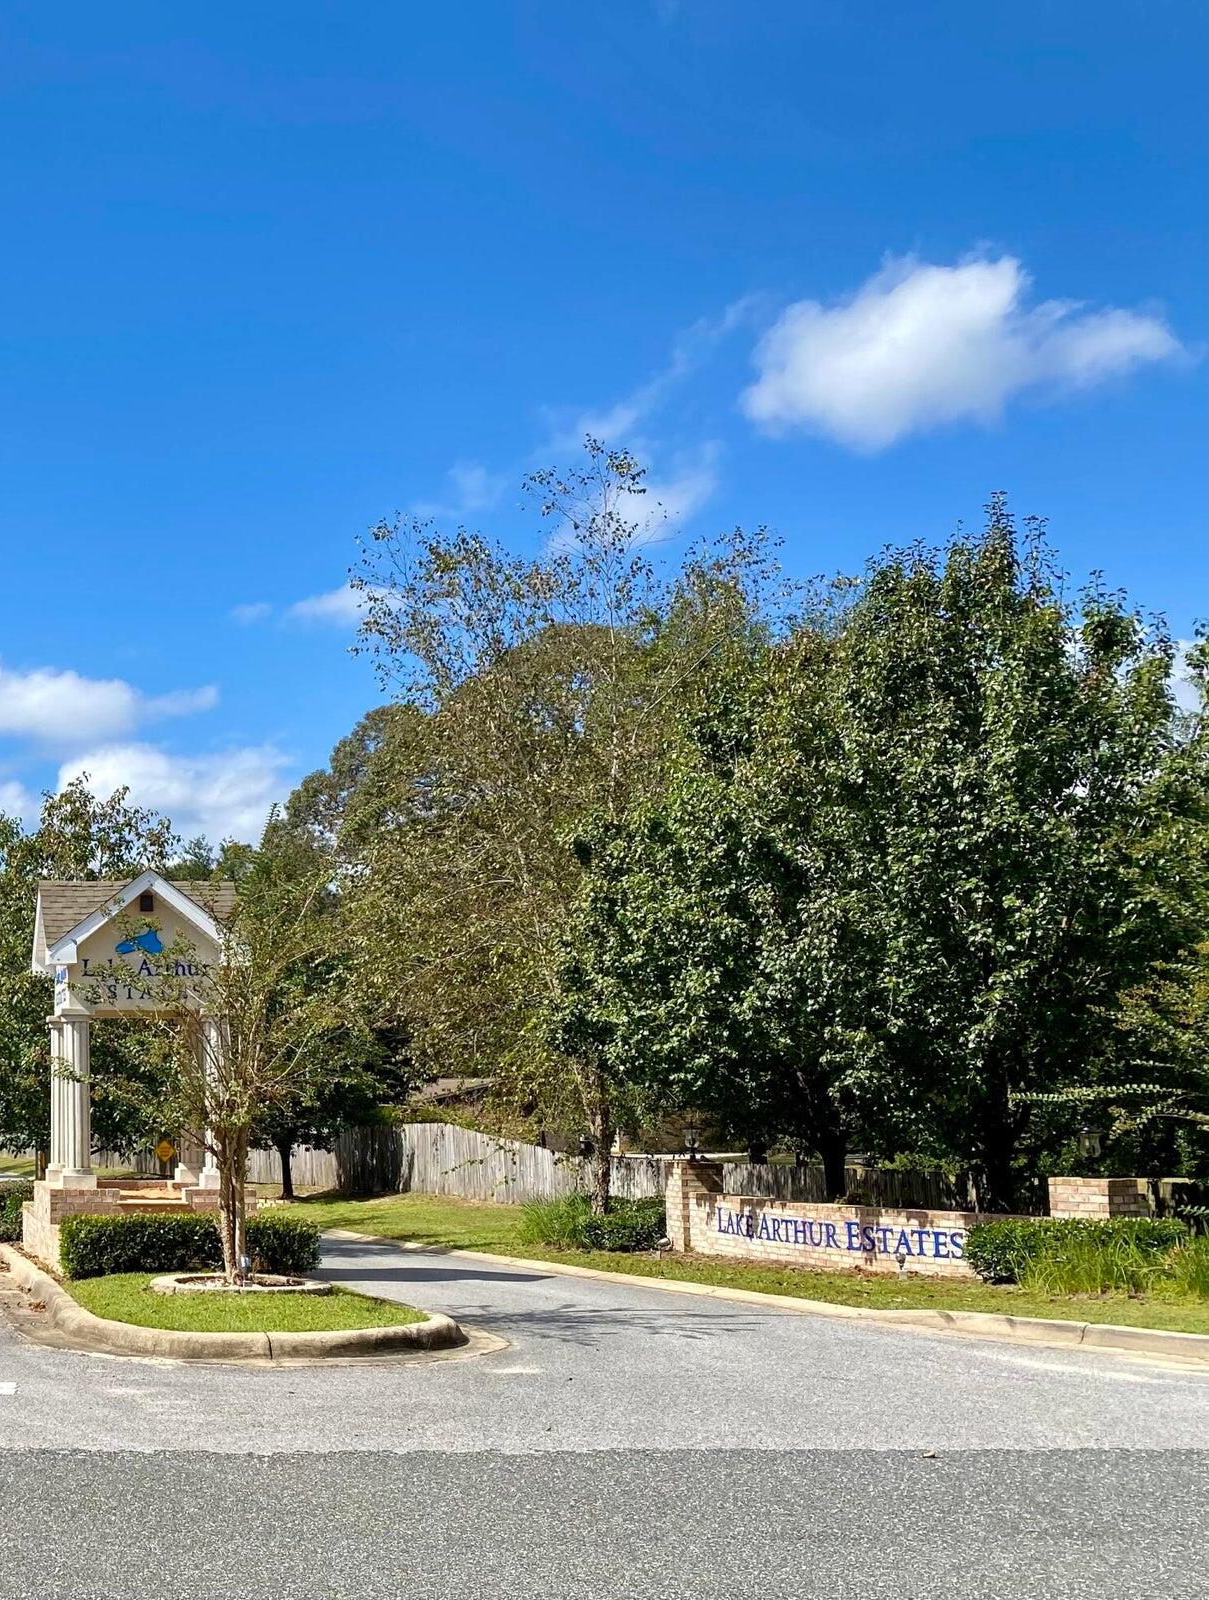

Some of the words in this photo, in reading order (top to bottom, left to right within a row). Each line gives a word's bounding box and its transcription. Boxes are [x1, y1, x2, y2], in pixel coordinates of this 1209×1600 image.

[717, 1207, 754, 1239] LAKE
[758, 1213, 839, 1248] ARTHUR
[846, 1221, 964, 1259] ESTATES
